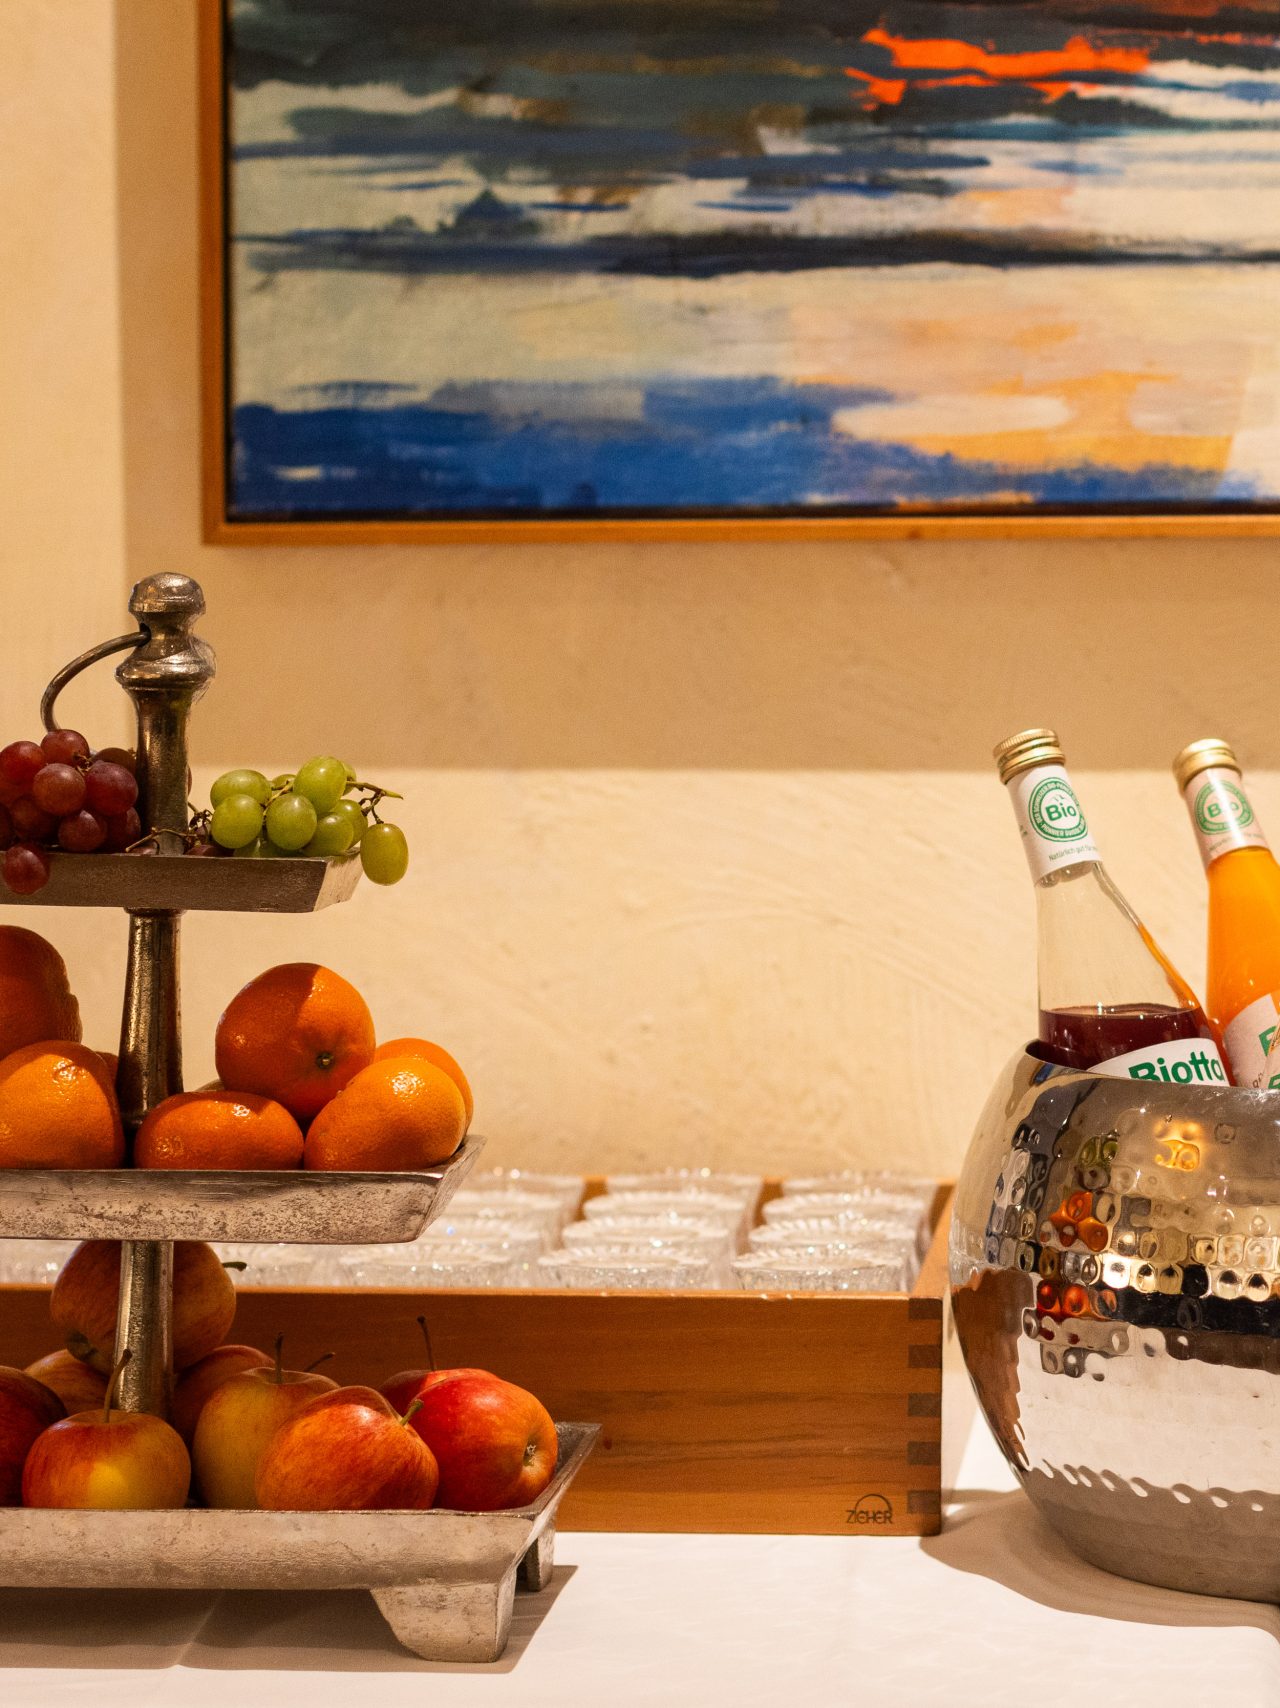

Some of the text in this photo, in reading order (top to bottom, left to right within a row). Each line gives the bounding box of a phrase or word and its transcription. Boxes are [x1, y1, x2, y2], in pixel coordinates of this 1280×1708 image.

[1045, 802, 1077, 821] Bio
[1207, 802, 1239, 818] Bo
[1128, 1051, 1226, 1084] Biotta
